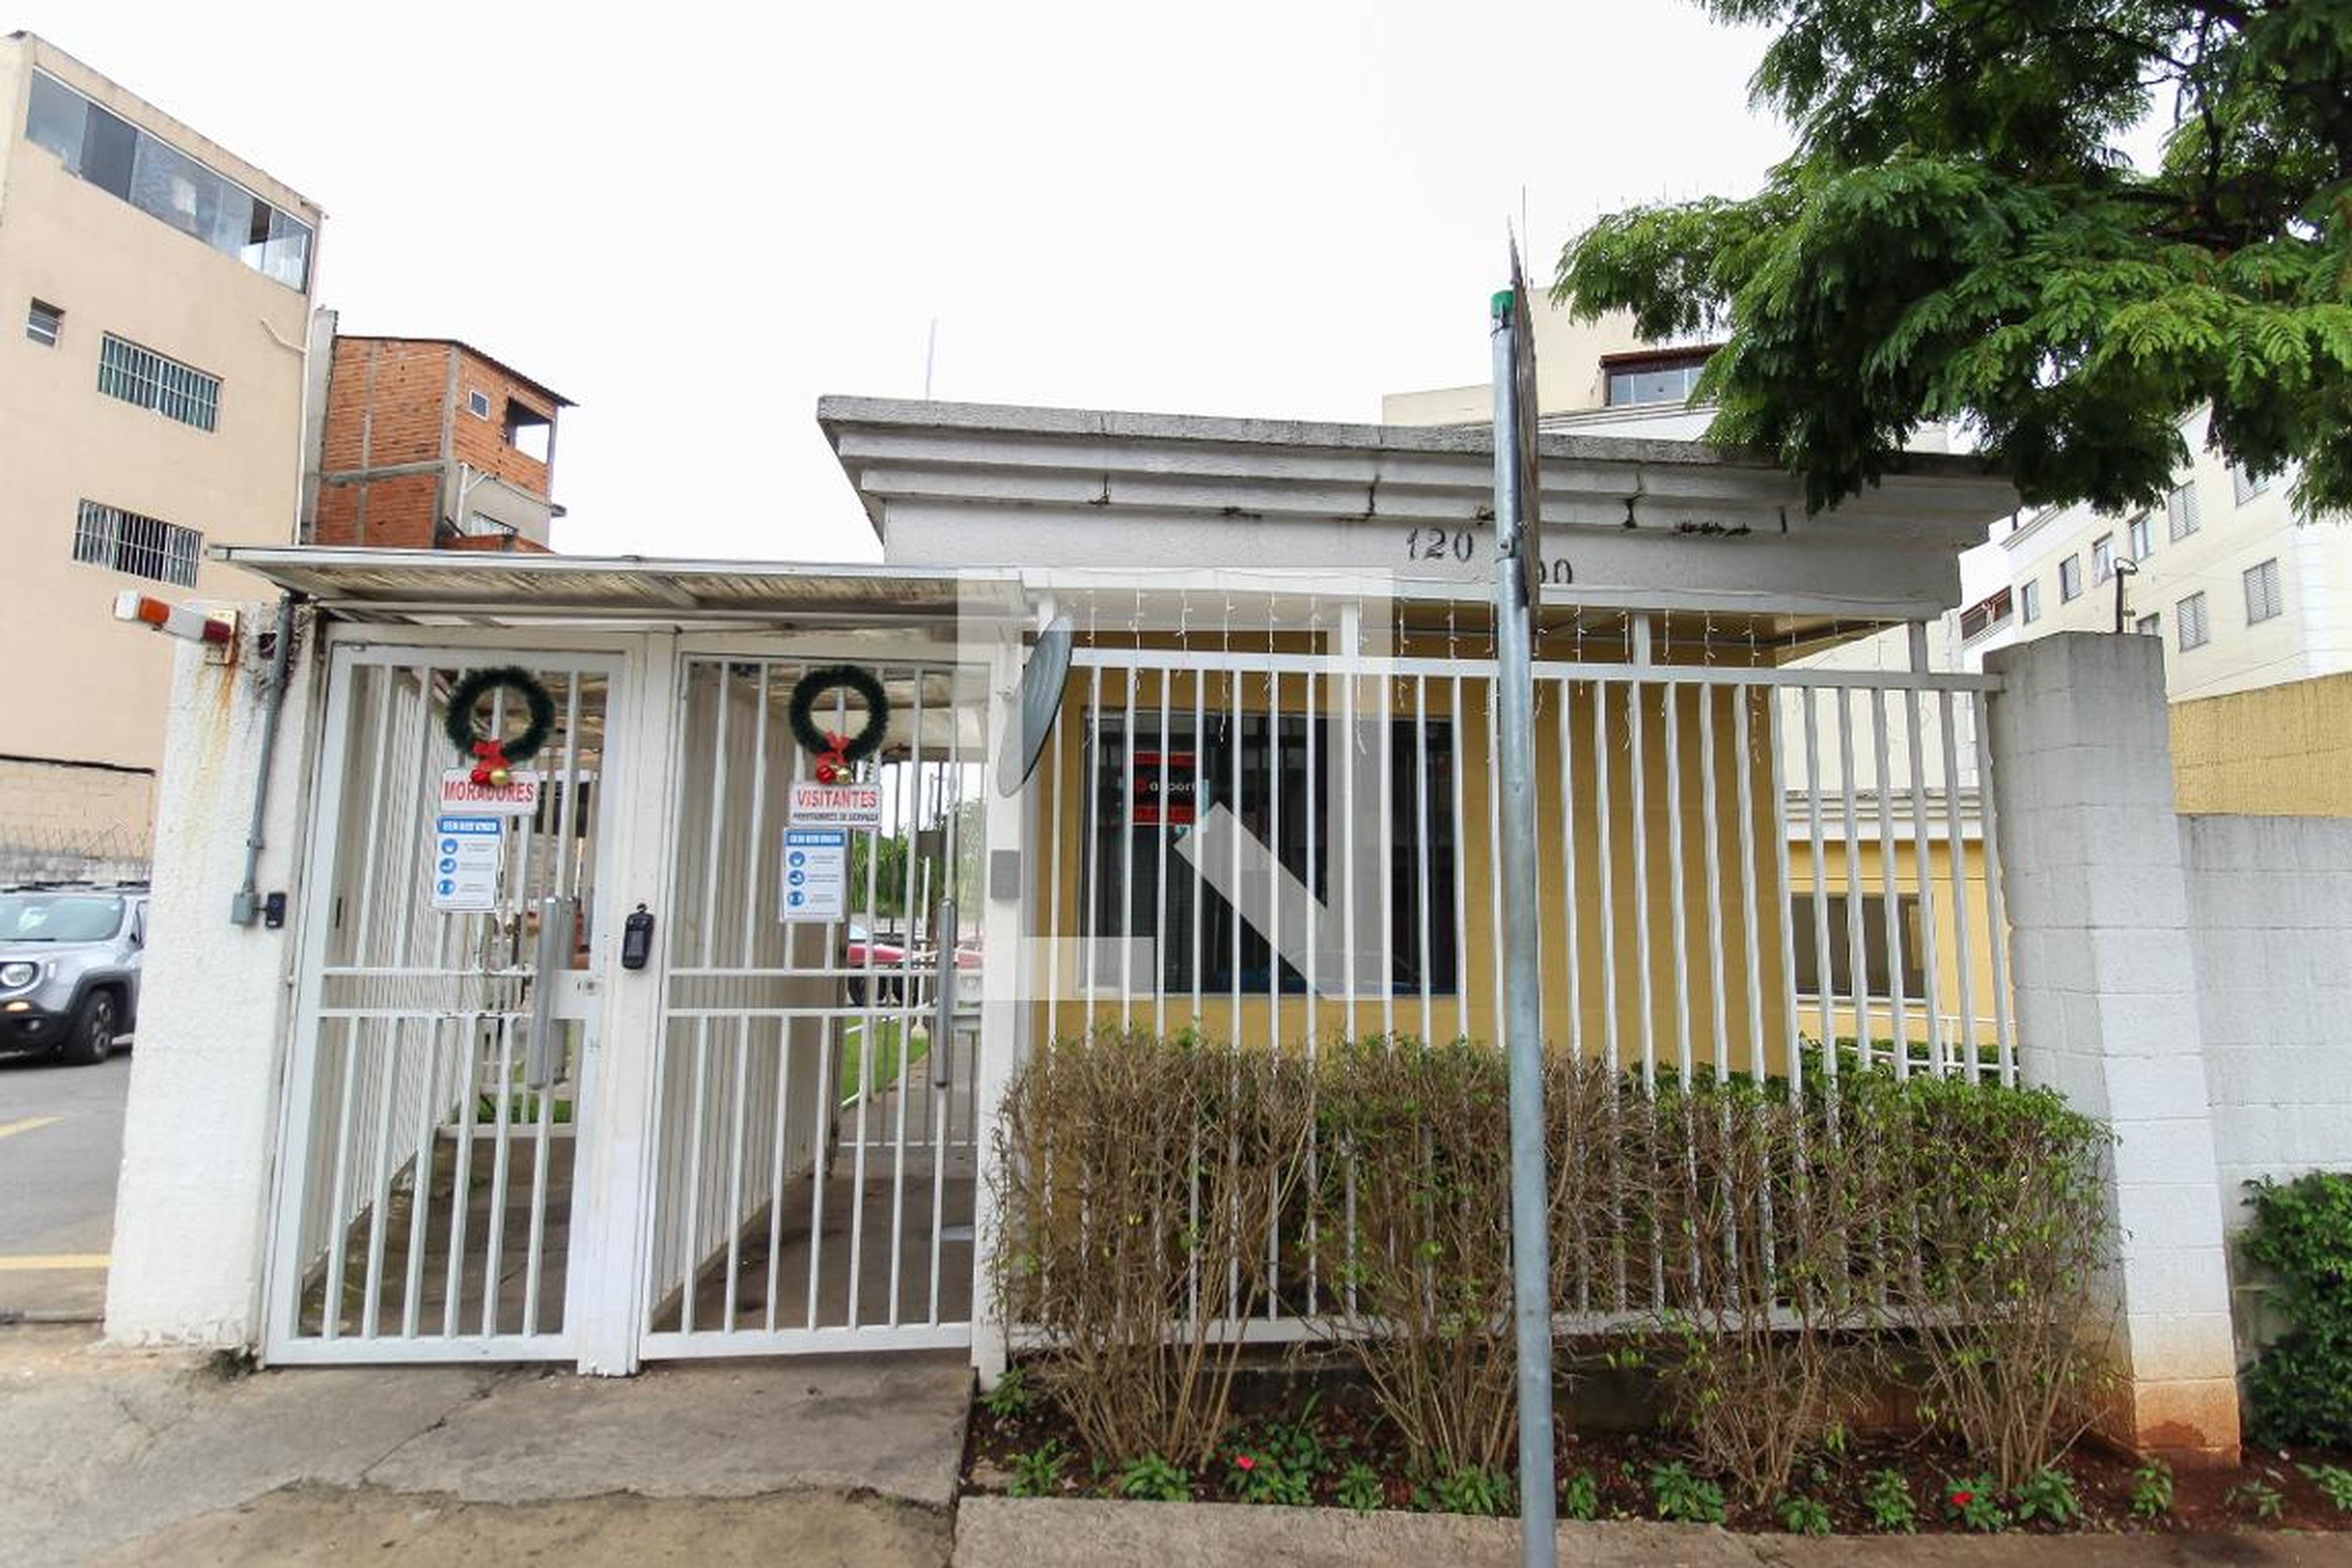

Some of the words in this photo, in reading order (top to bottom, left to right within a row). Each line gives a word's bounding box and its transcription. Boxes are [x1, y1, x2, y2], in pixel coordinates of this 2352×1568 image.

[1406, 527, 1473, 562] 120
[443, 781, 534, 802] MORADORES
[797, 789, 877, 808] VISITANTES
